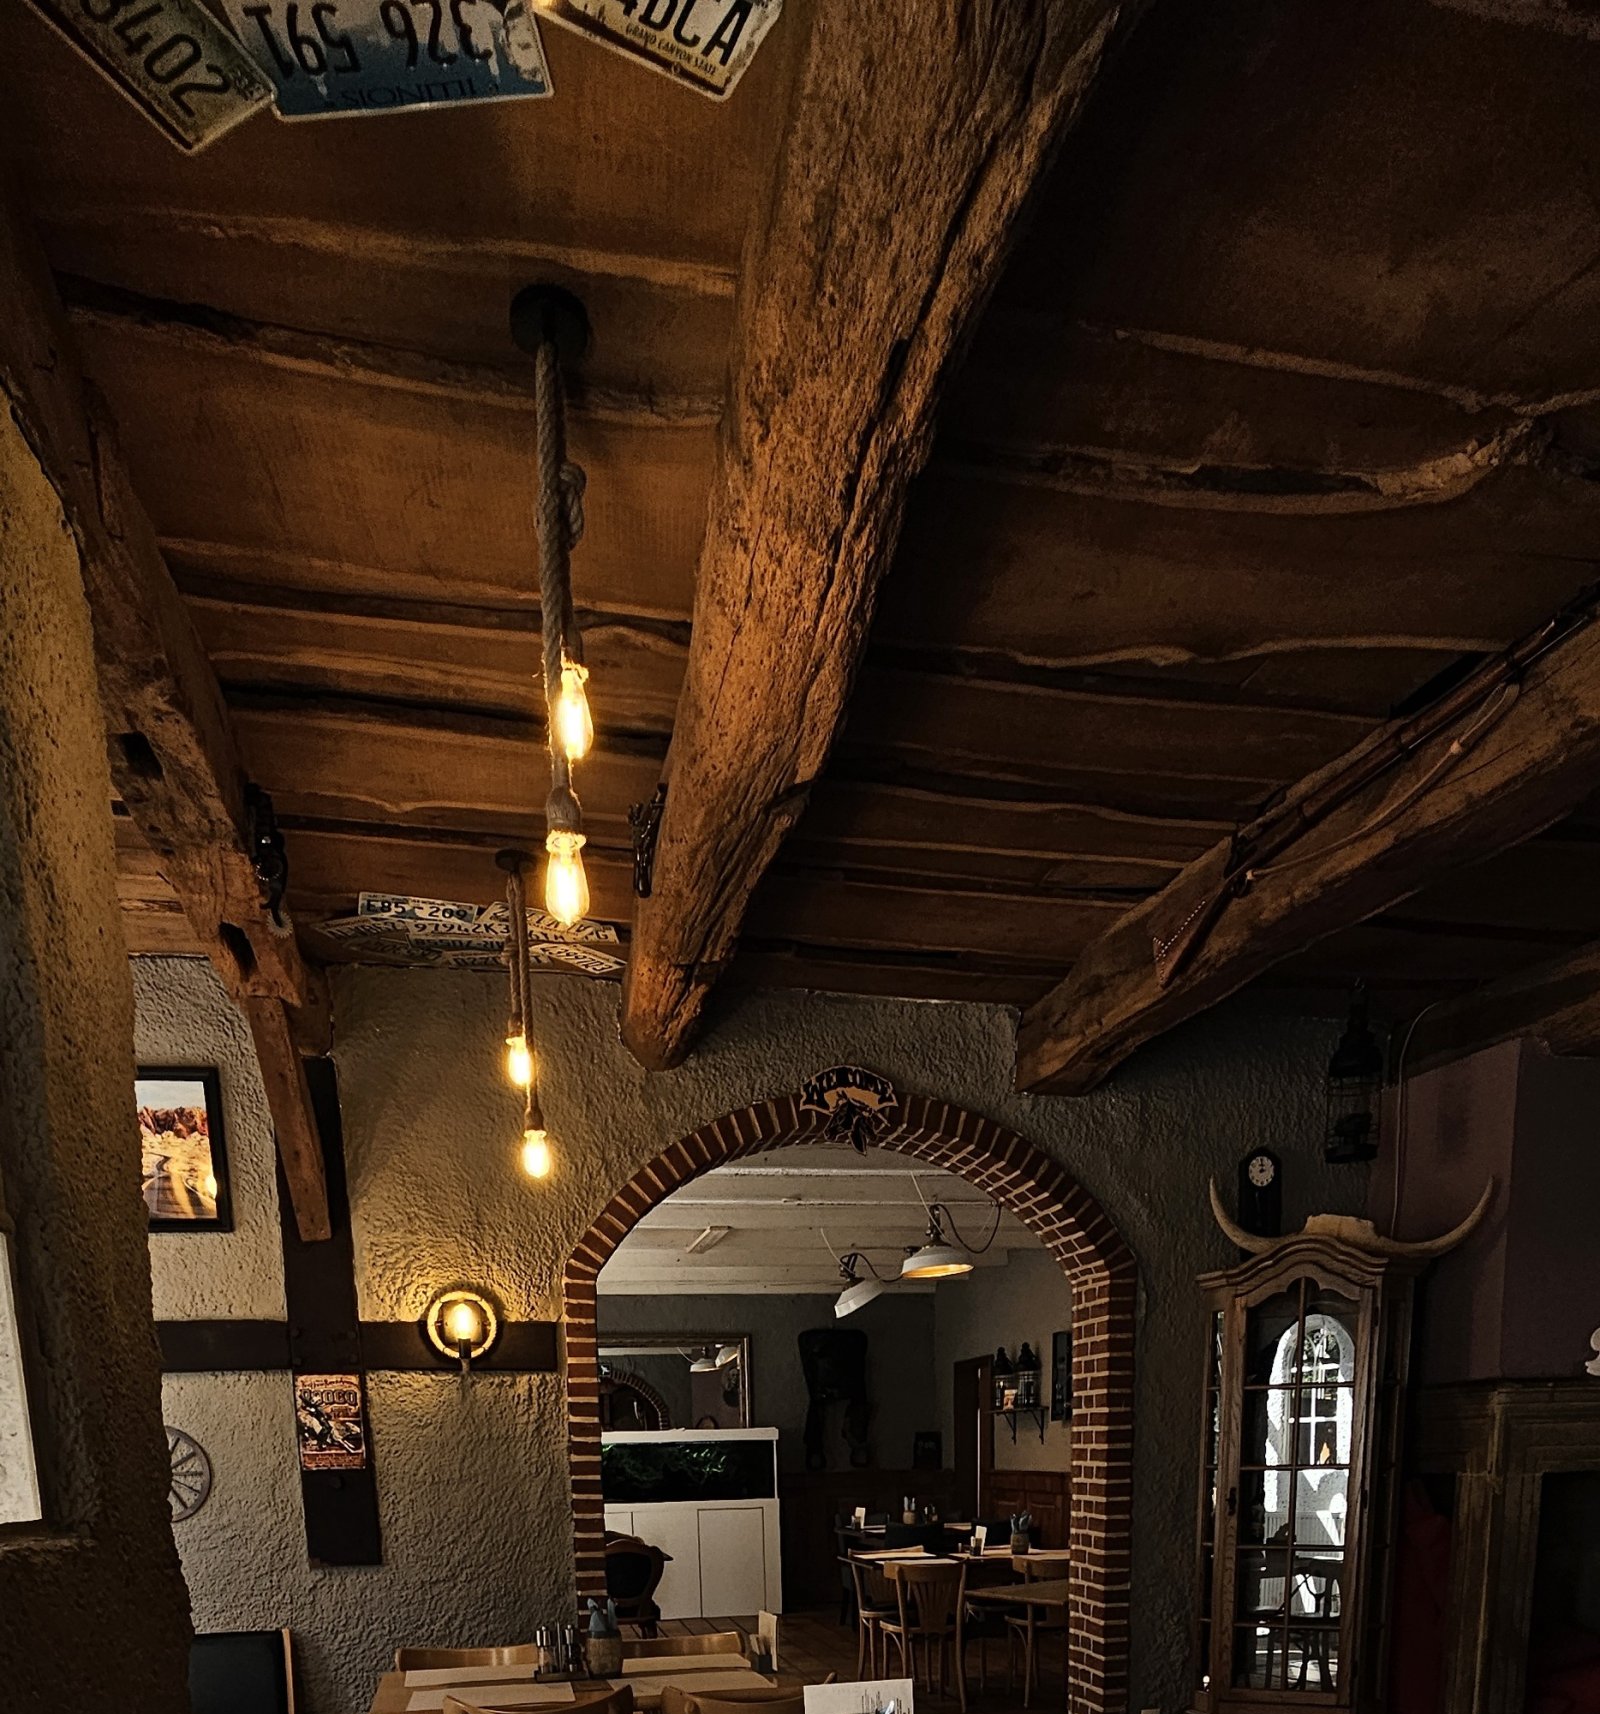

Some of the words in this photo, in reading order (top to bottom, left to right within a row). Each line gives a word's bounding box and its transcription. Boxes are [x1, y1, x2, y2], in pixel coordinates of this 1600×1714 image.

[623, 0, 753, 66] DCA
[625, 22, 657, 45] GRAND
[657, 38, 692, 64] CANYON
[694, 56, 717, 76] STATE
